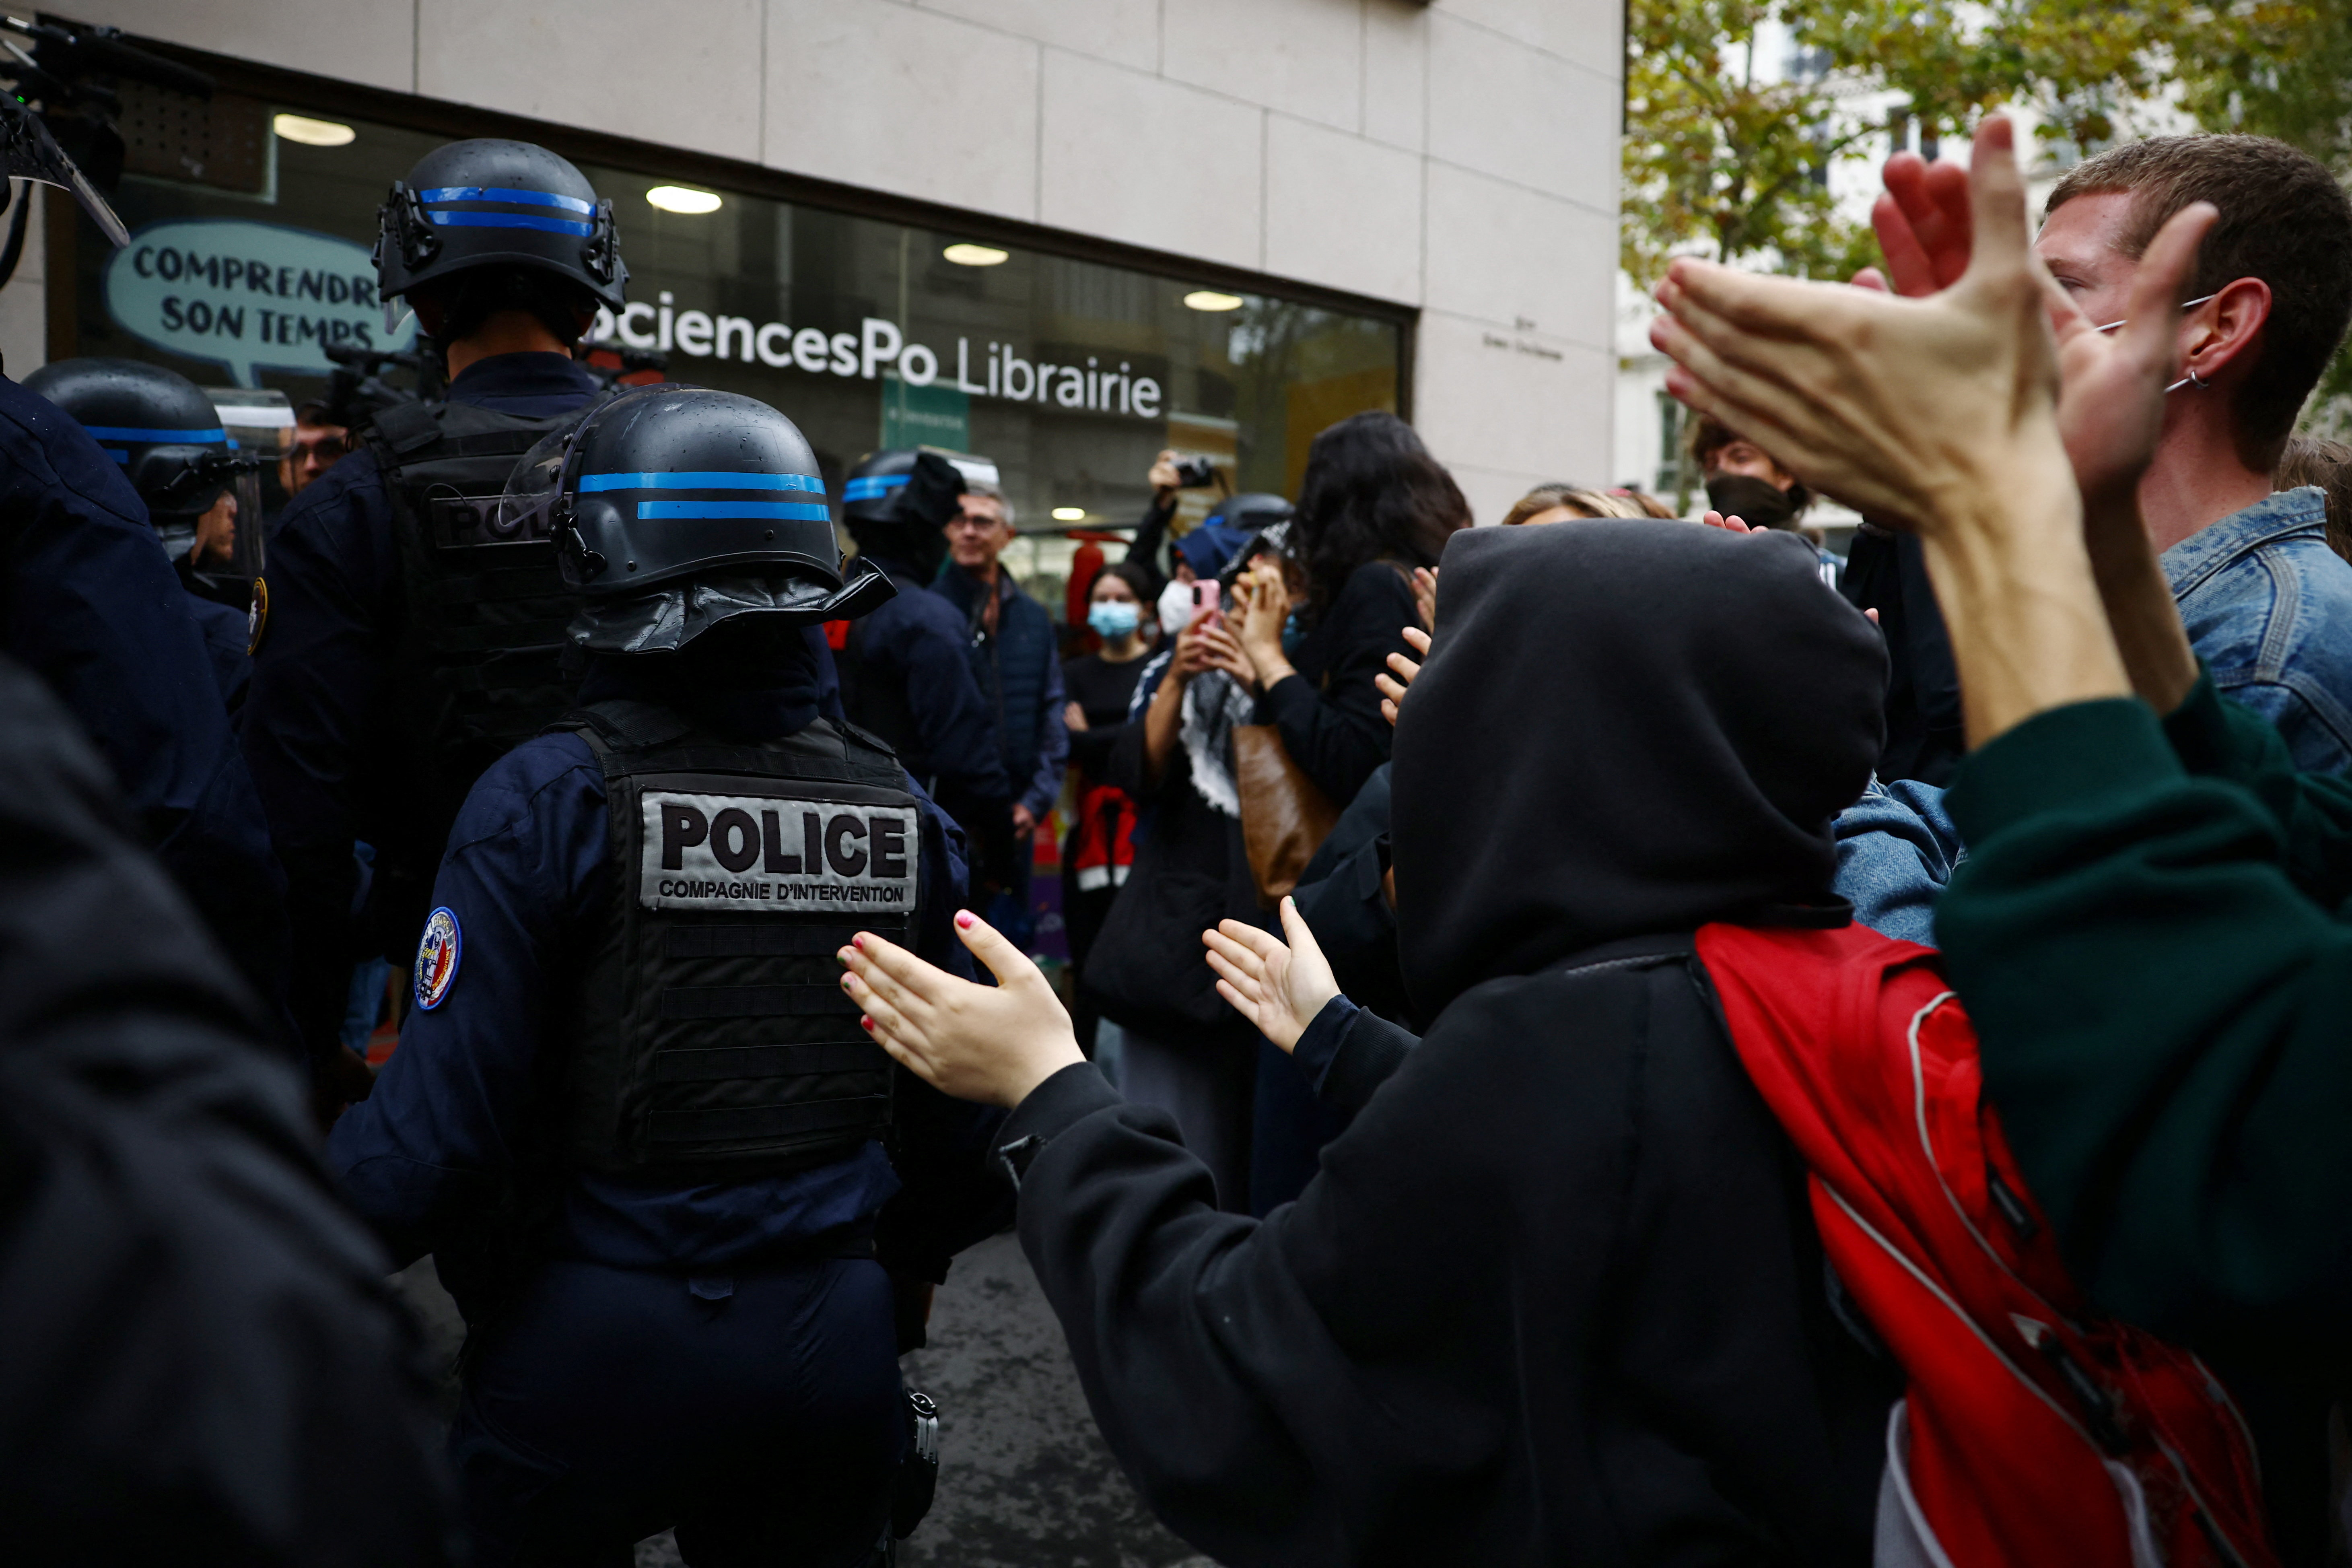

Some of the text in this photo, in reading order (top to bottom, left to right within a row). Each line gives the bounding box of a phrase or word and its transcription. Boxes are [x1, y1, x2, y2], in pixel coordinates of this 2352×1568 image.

[133, 245, 385, 310] COMPRENDR
[161, 296, 373, 350] SON TEMPS
[957, 336, 1160, 417] Librairie
[448, 501, 550, 540] POL
[661, 803, 907, 878] POLICE
[659, 880, 903, 902] COMPAGNIE D'INTERVENTION
